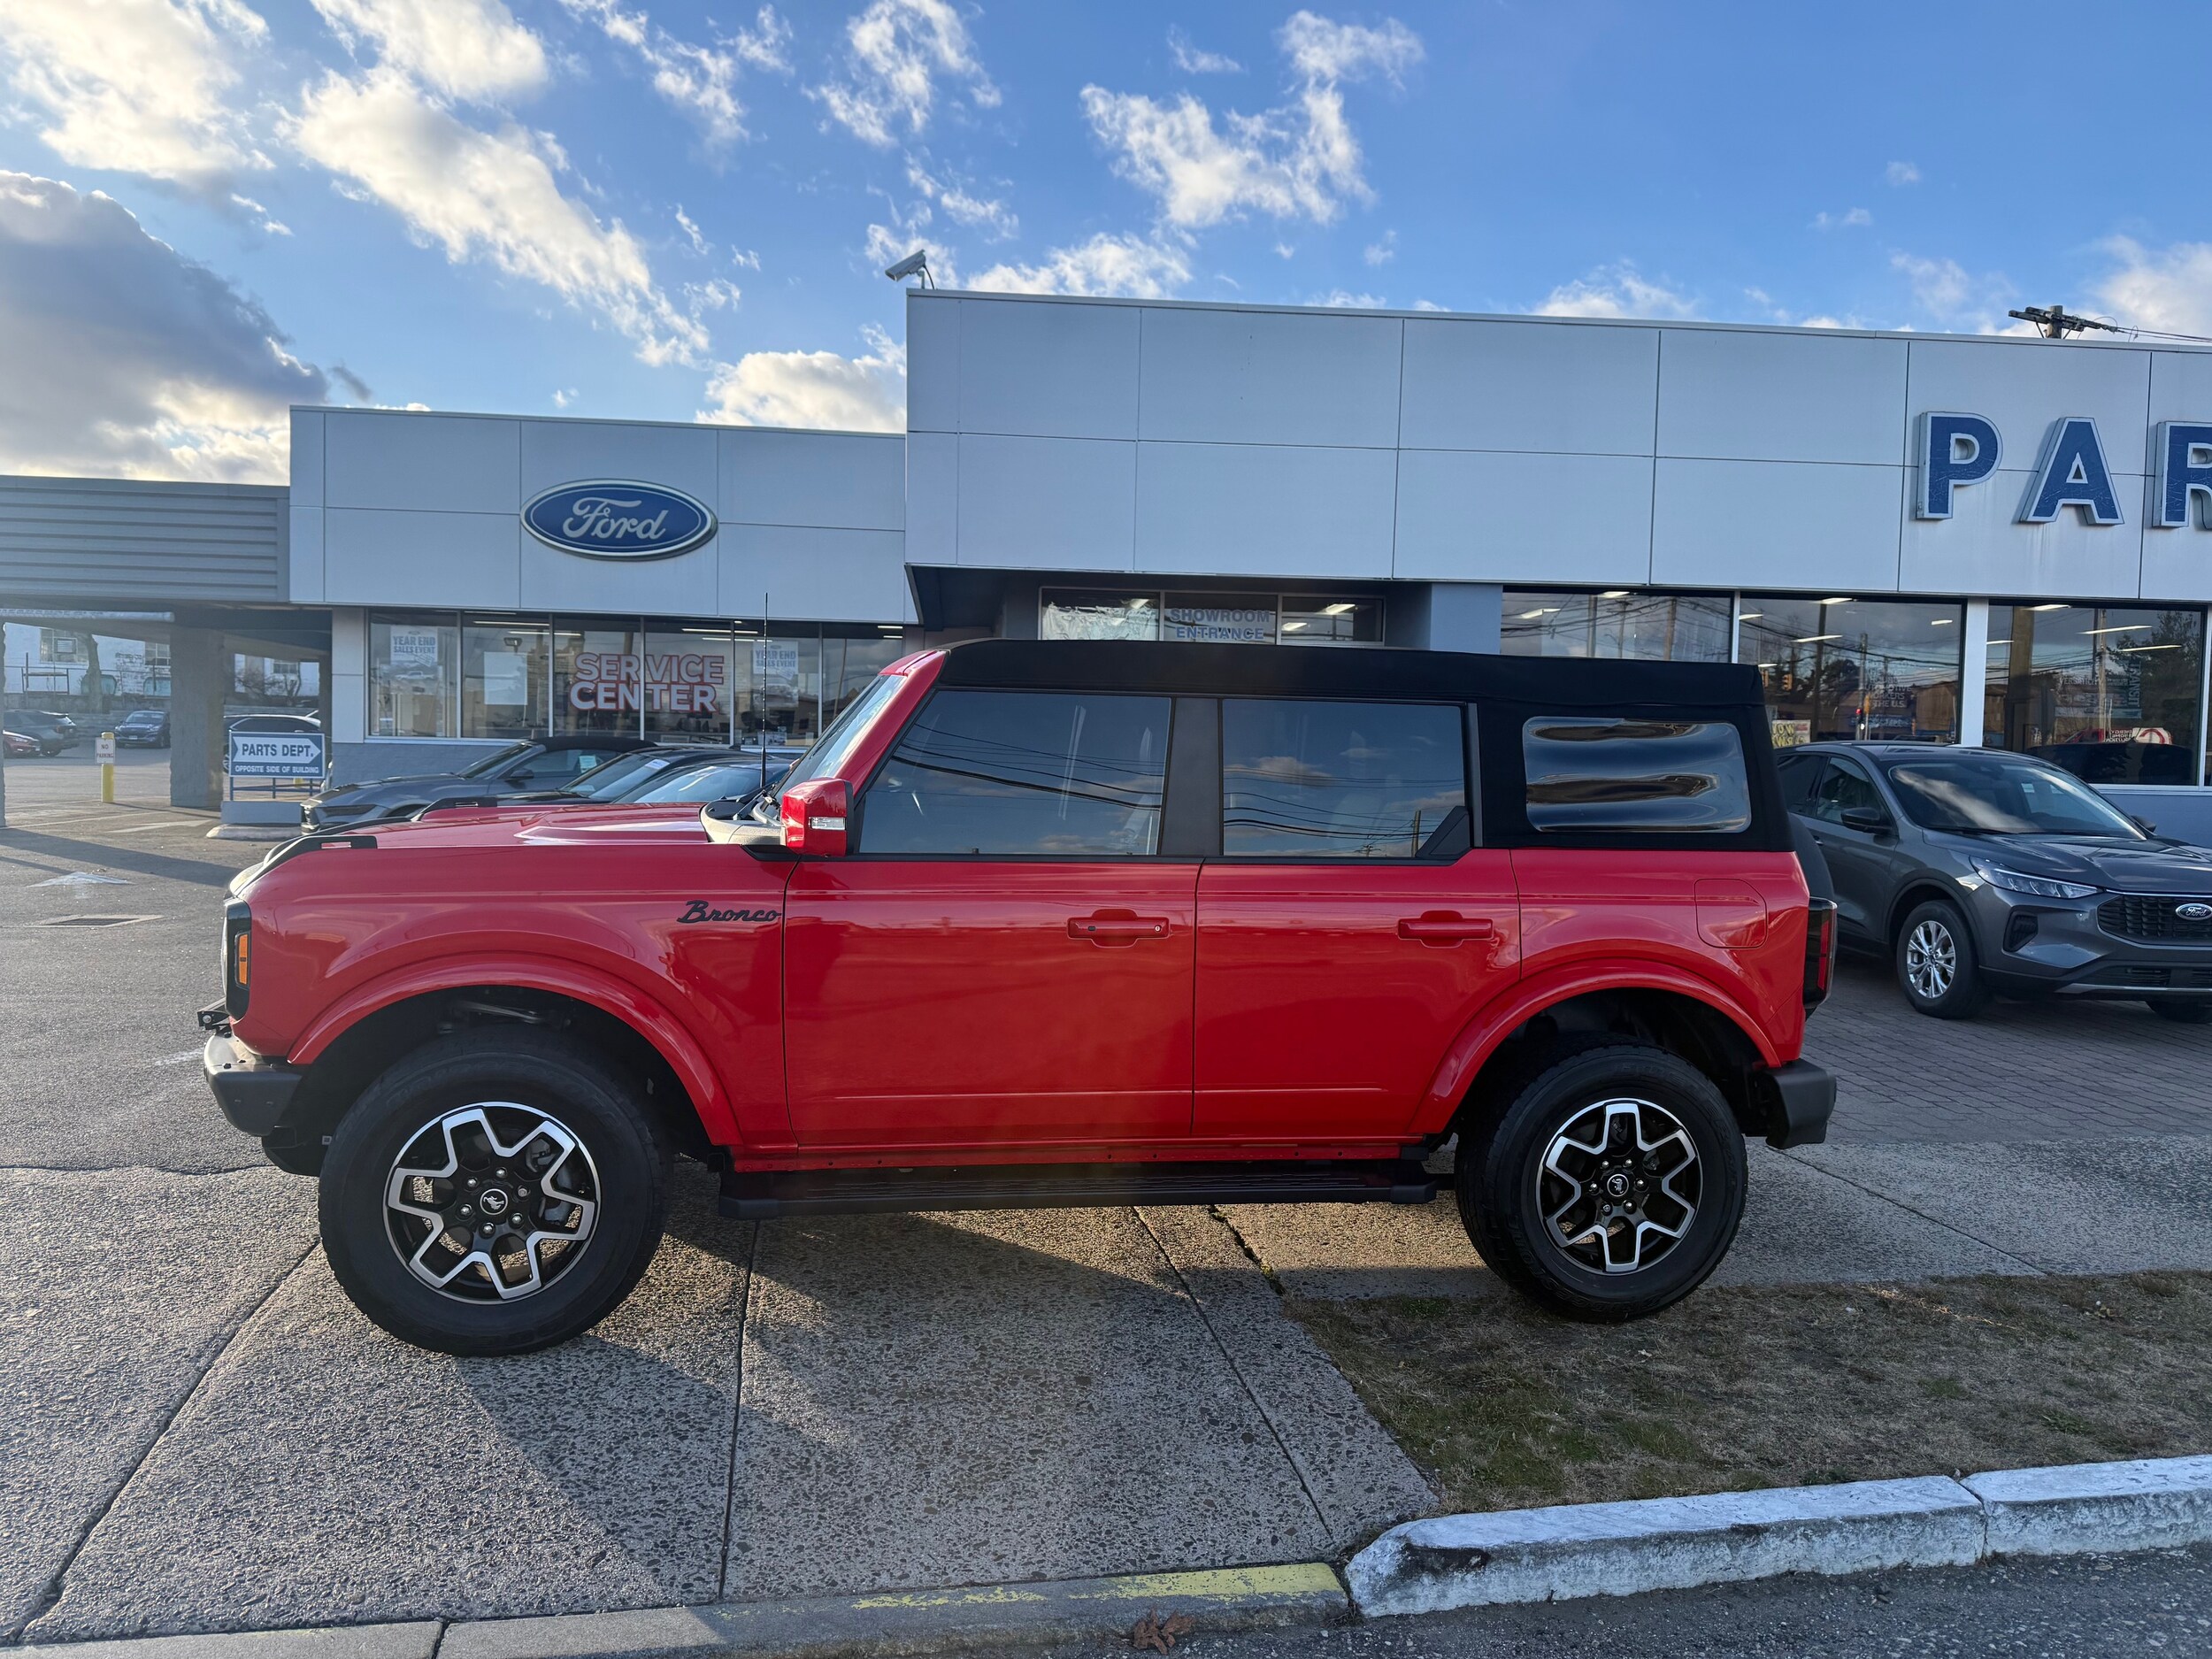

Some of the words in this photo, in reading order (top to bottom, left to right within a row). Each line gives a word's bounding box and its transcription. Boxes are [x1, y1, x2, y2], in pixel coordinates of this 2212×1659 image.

[1916, 411, 2212, 528] PAR
[562, 496, 669, 540] Ford
[1170, 608, 1270, 623] SHOWROOM
[1175, 626, 1264, 640] ENTRANCE
[393, 636, 416, 646] YEAR
[418, 636, 435, 646] END
[779, 650, 796, 660] END
[575, 652, 724, 685] SERVICE
[570, 680, 718, 713] CENTER
[242, 743, 277, 757] PARTS
[281, 744, 314, 757] DEPT.
[676, 900, 781, 924] Bronco
[2185, 906, 2208, 917] Ford
